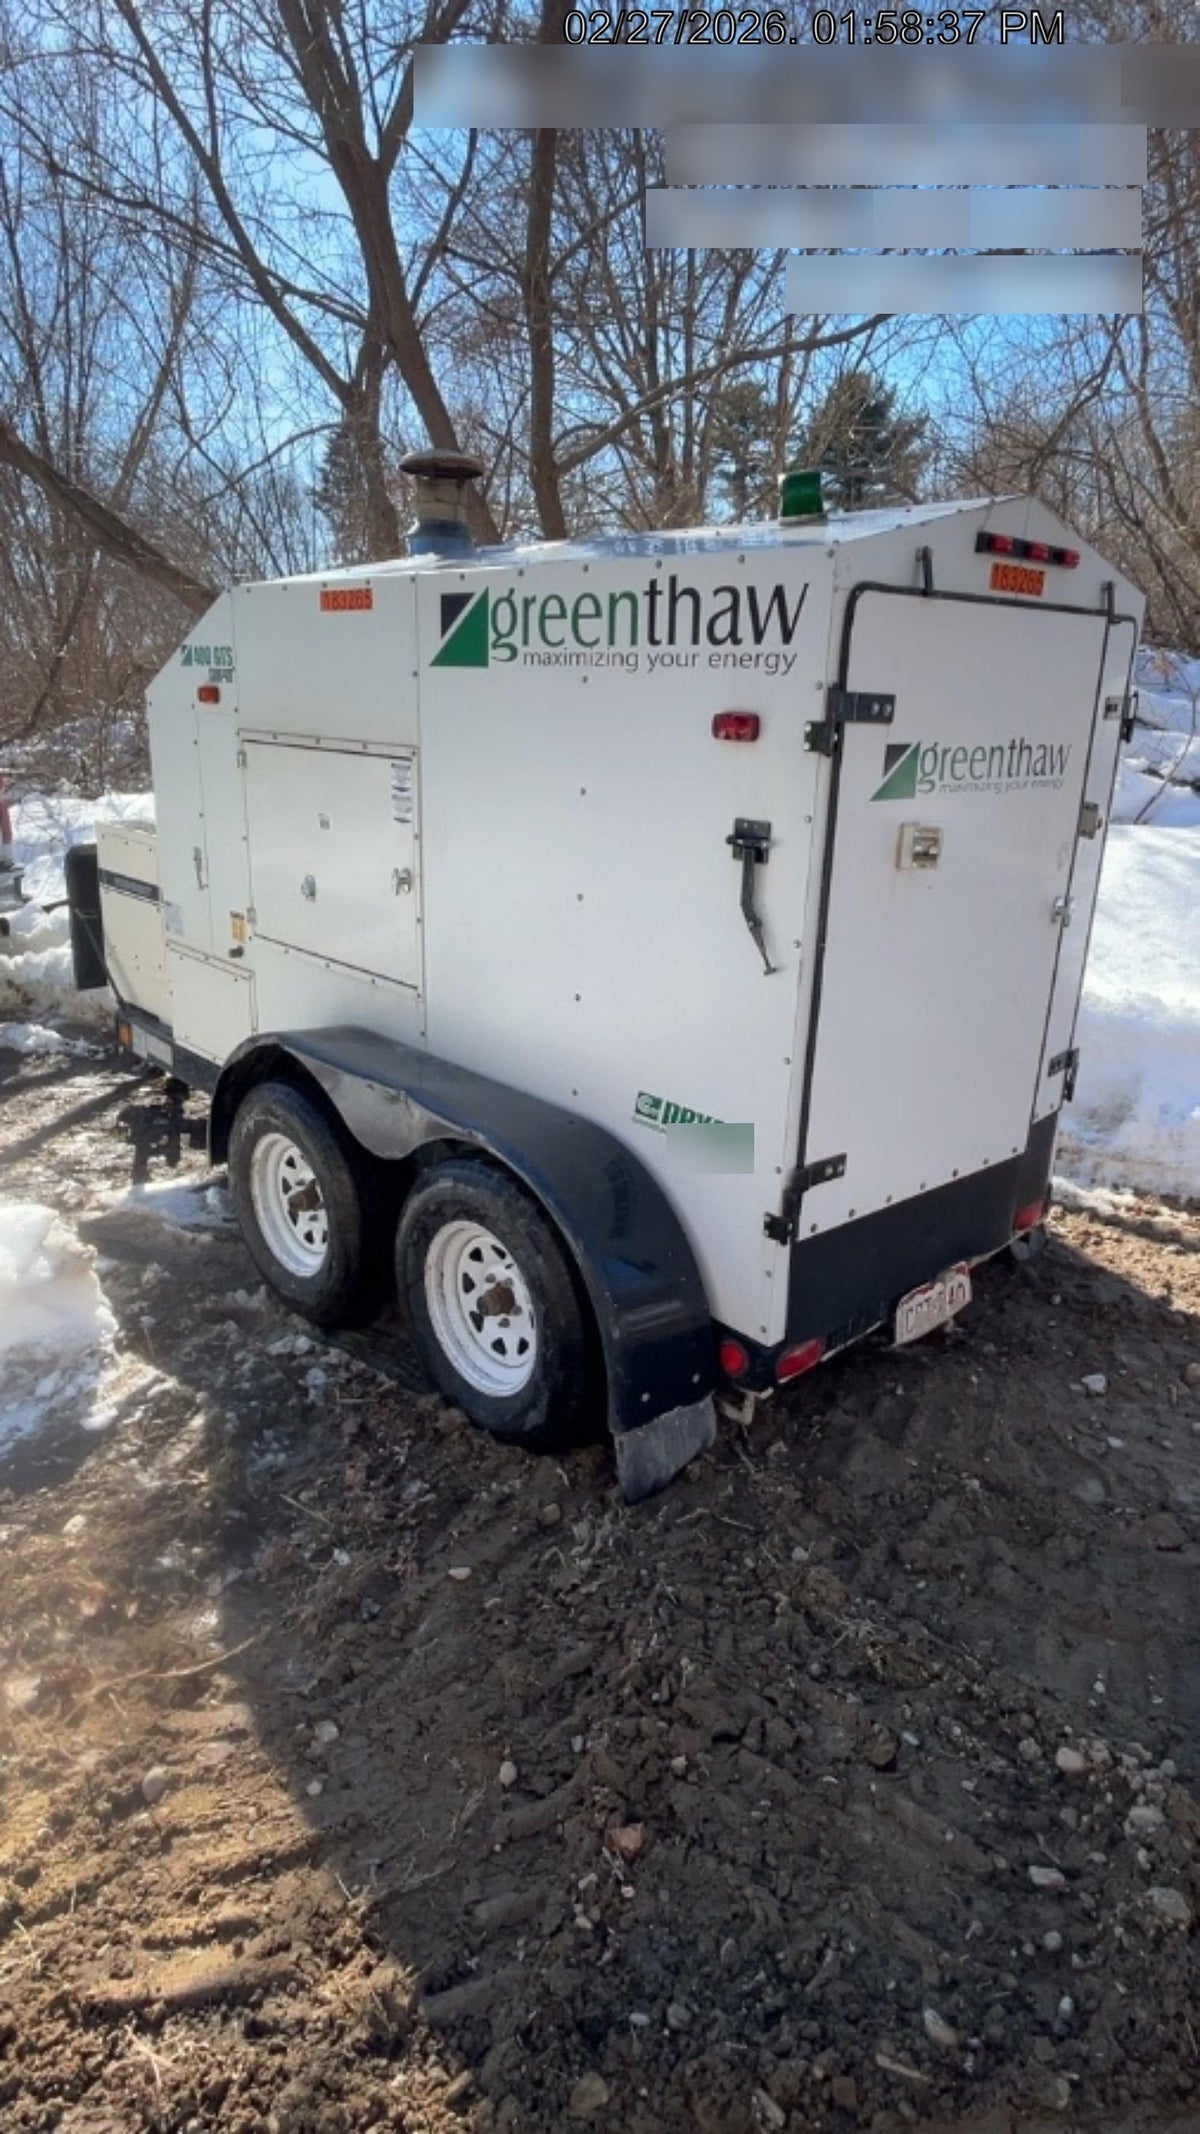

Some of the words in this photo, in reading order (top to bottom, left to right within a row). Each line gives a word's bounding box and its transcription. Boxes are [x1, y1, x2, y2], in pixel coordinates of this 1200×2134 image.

[992, 563, 1045, 595] 183265
[322, 588, 372, 611] 183265
[490, 574, 810, 662] greenthaw
[523, 647, 639, 673] maximizing
[647, 651, 700, 673] your
[708, 651, 798, 676] energy
[917, 737, 1073, 794] greenthaw
